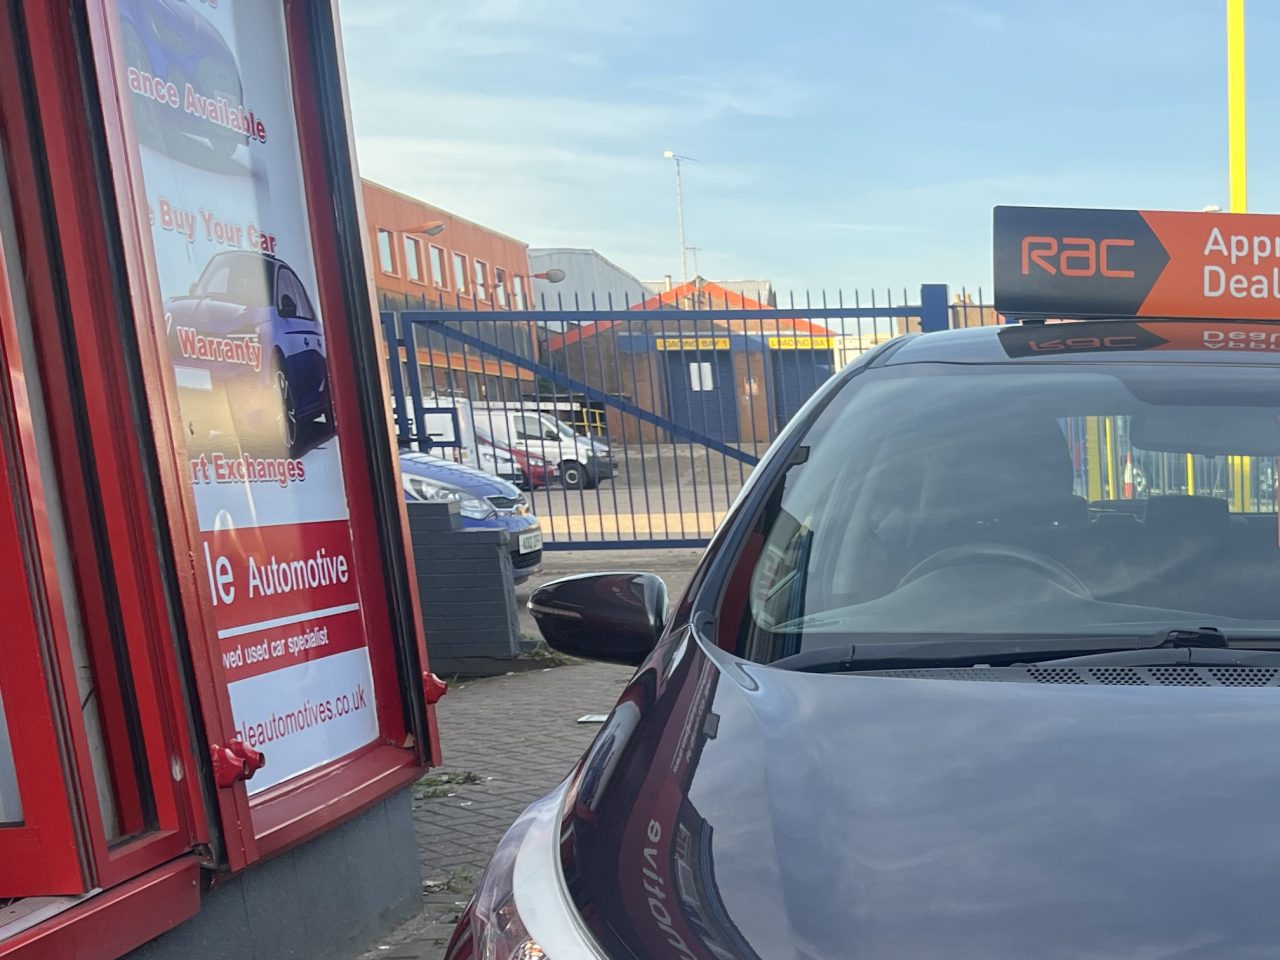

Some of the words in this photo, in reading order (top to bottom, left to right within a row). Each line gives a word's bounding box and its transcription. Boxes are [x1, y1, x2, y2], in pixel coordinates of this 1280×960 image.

[128, 66, 180, 109] ance
[184, 83, 267, 144] Available
[158, 197, 196, 243] Buy
[199, 208, 243, 247] Your
[247, 223, 277, 256] Car
[176, 326, 261, 372] Warranty
[771, 339, 809, 347] LOADNG
[211, 452, 305, 487] Exchanges
[204, 541, 235, 606] le
[249, 547, 349, 598] Automotive
[245, 639, 270, 664] used
[271, 639, 286, 658] car
[287, 625, 329, 656] specialist
